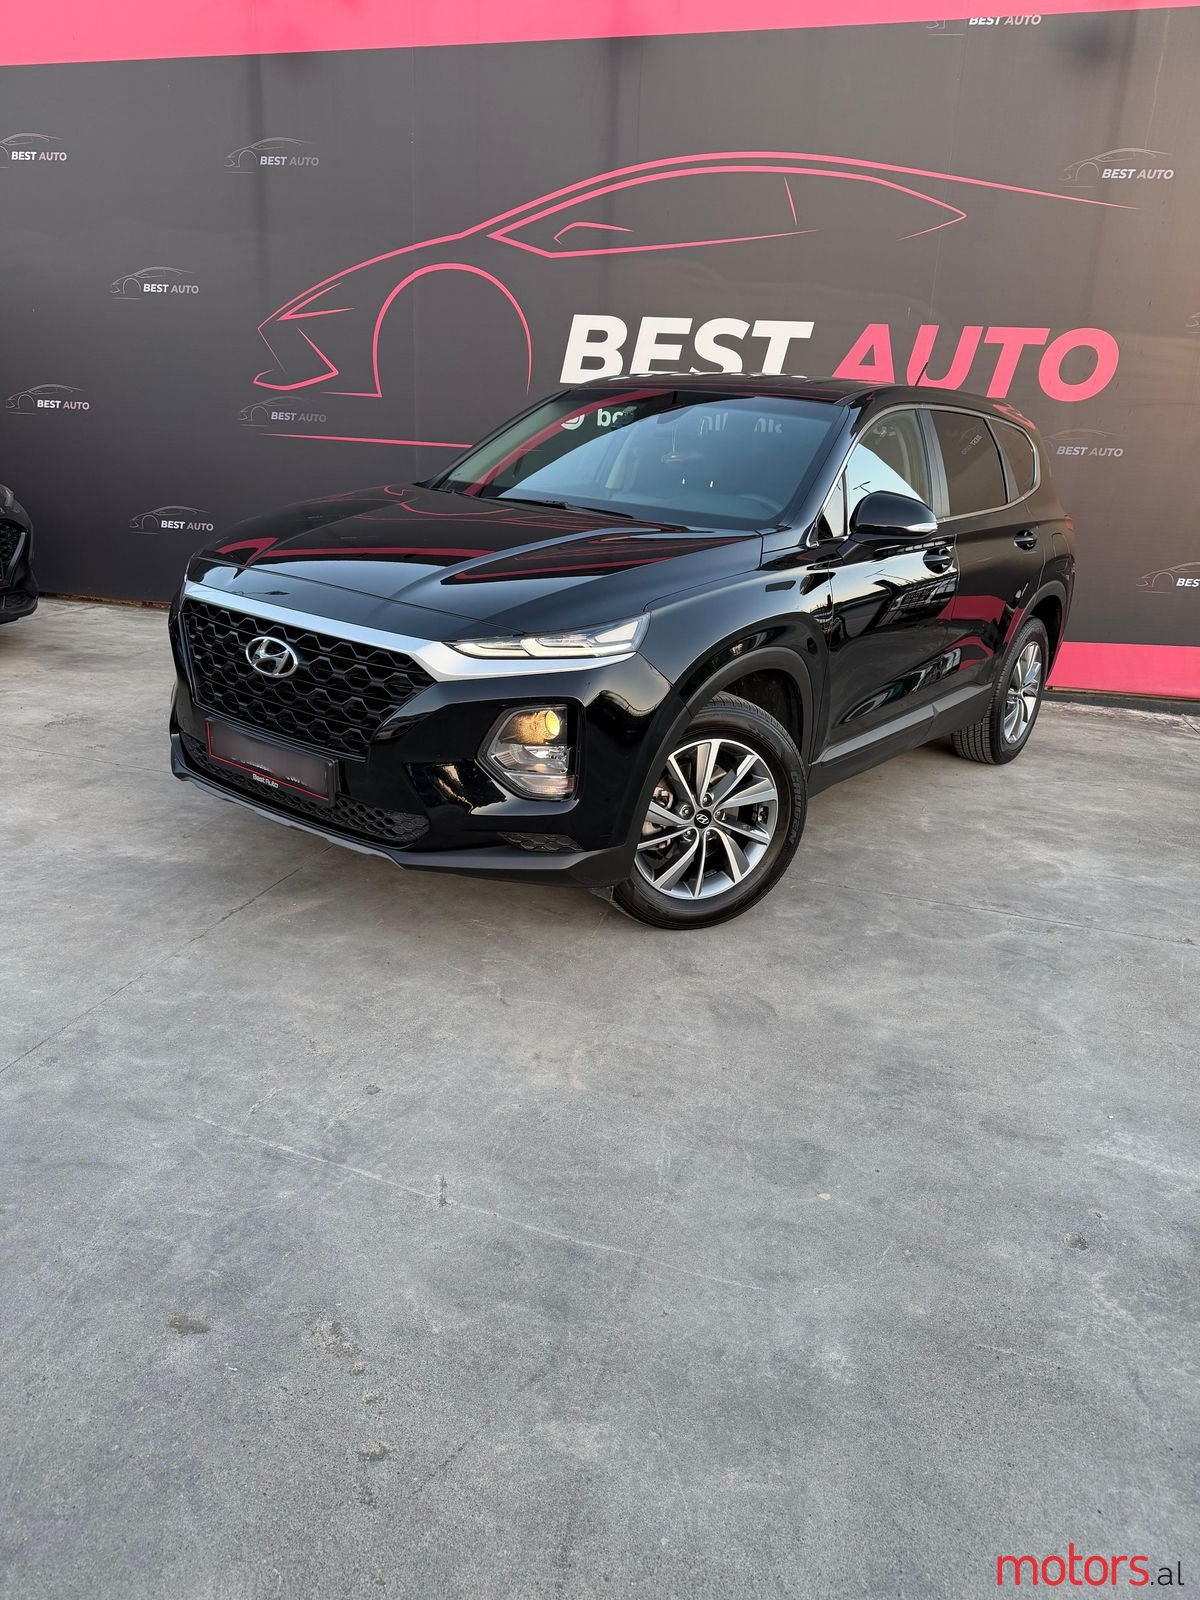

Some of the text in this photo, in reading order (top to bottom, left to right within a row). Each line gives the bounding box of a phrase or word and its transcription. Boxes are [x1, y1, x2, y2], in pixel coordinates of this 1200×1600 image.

[968, 14, 1042, 26] BEST AUTO
[11, 151, 67, 161] BEST AUTO
[260, 156, 319, 166] BEST AUTO
[1102, 168, 1174, 180] BEST AUTO
[143, 283, 199, 294] BEST AUTO
[559, 314, 1120, 402] BEST AUTO
[37, 399, 90, 410] BEST AUTO
[271, 411, 327, 422] BEST AUTO
[1056, 446, 1123, 457] BEST AUTO
[161, 520, 214, 531] BEST AUTO
[1176, 577, 1200, 587] BES
